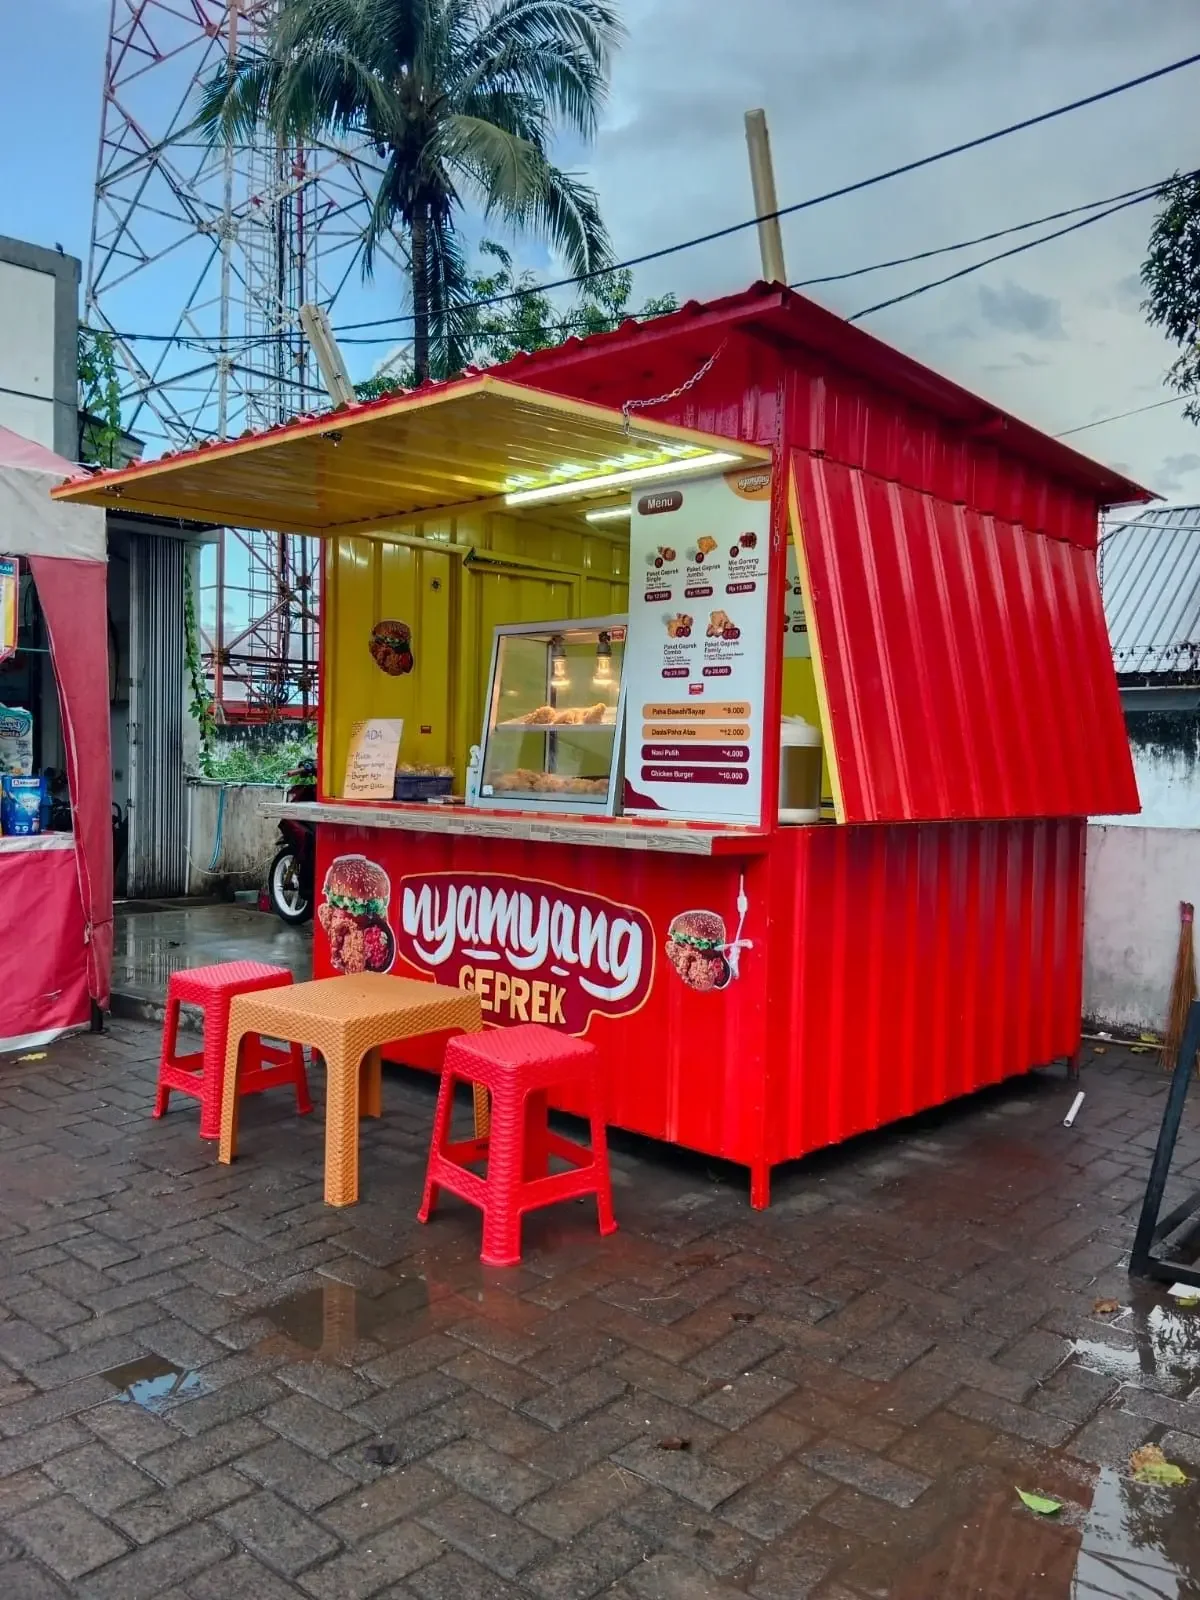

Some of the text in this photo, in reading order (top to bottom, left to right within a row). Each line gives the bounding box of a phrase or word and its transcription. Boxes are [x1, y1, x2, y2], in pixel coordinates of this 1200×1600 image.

[647, 497, 673, 510] Menu
[673, 770, 694, 779] Burger
[458, 964, 568, 1025] GEPREK
